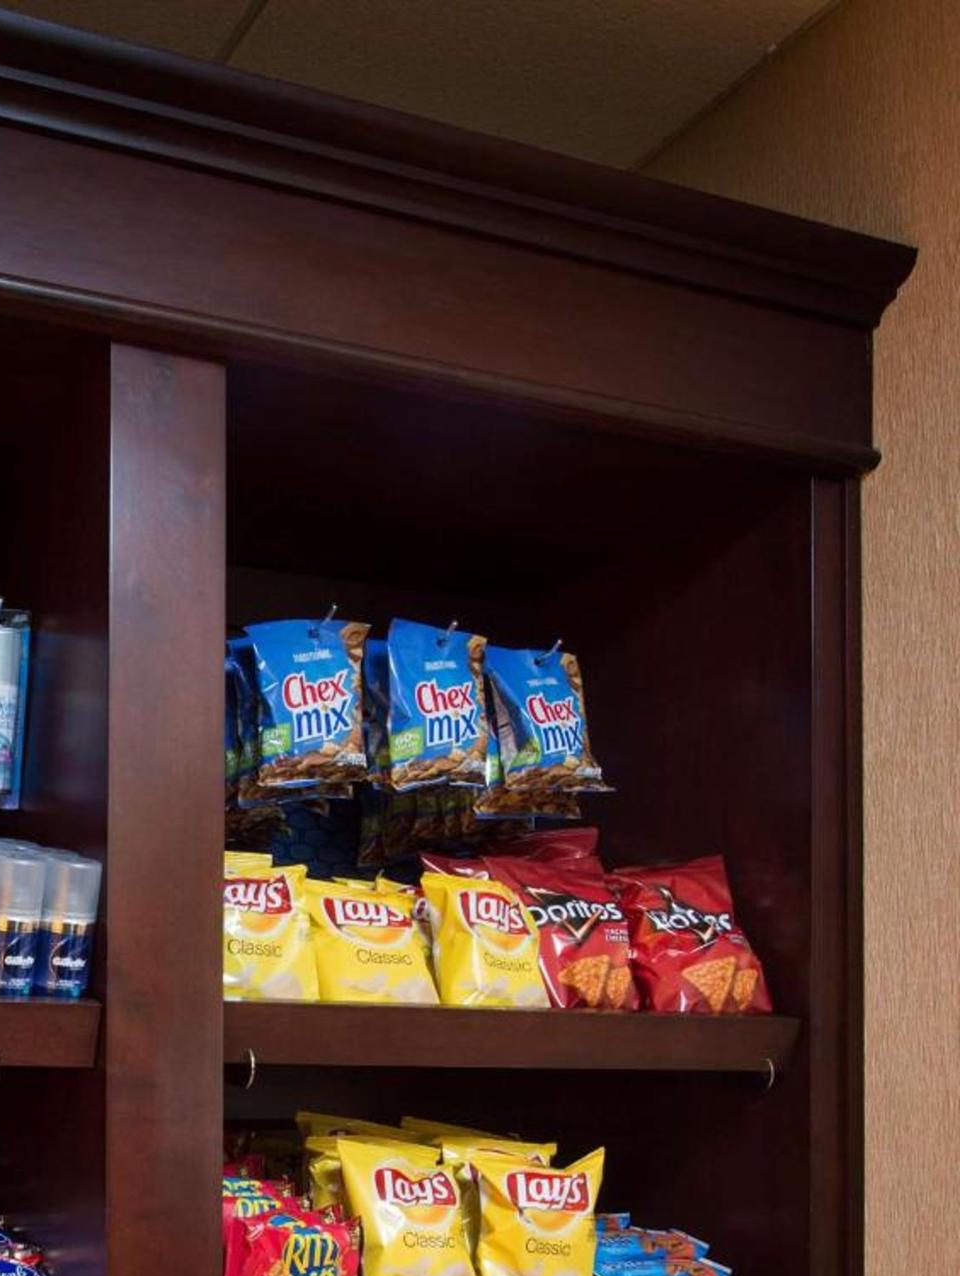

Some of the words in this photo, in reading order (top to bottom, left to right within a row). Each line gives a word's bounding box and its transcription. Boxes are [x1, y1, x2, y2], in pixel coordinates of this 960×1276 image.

[282, 669, 349, 710] Chex
[416, 679, 473, 715] Chex
[293, 700, 351, 739] mix
[527, 692, 577, 725] Chex
[427, 709, 478, 745] mix
[542, 721, 583, 752] mix
[224, 877, 285, 914] ay's
[527, 899, 623, 927] Doritos
[227, 938, 283, 958] Classic
[356, 949, 413, 966] Classic
[287, 1231, 338, 1276] RITZ
[402, 1231, 456, 1250] Classic
